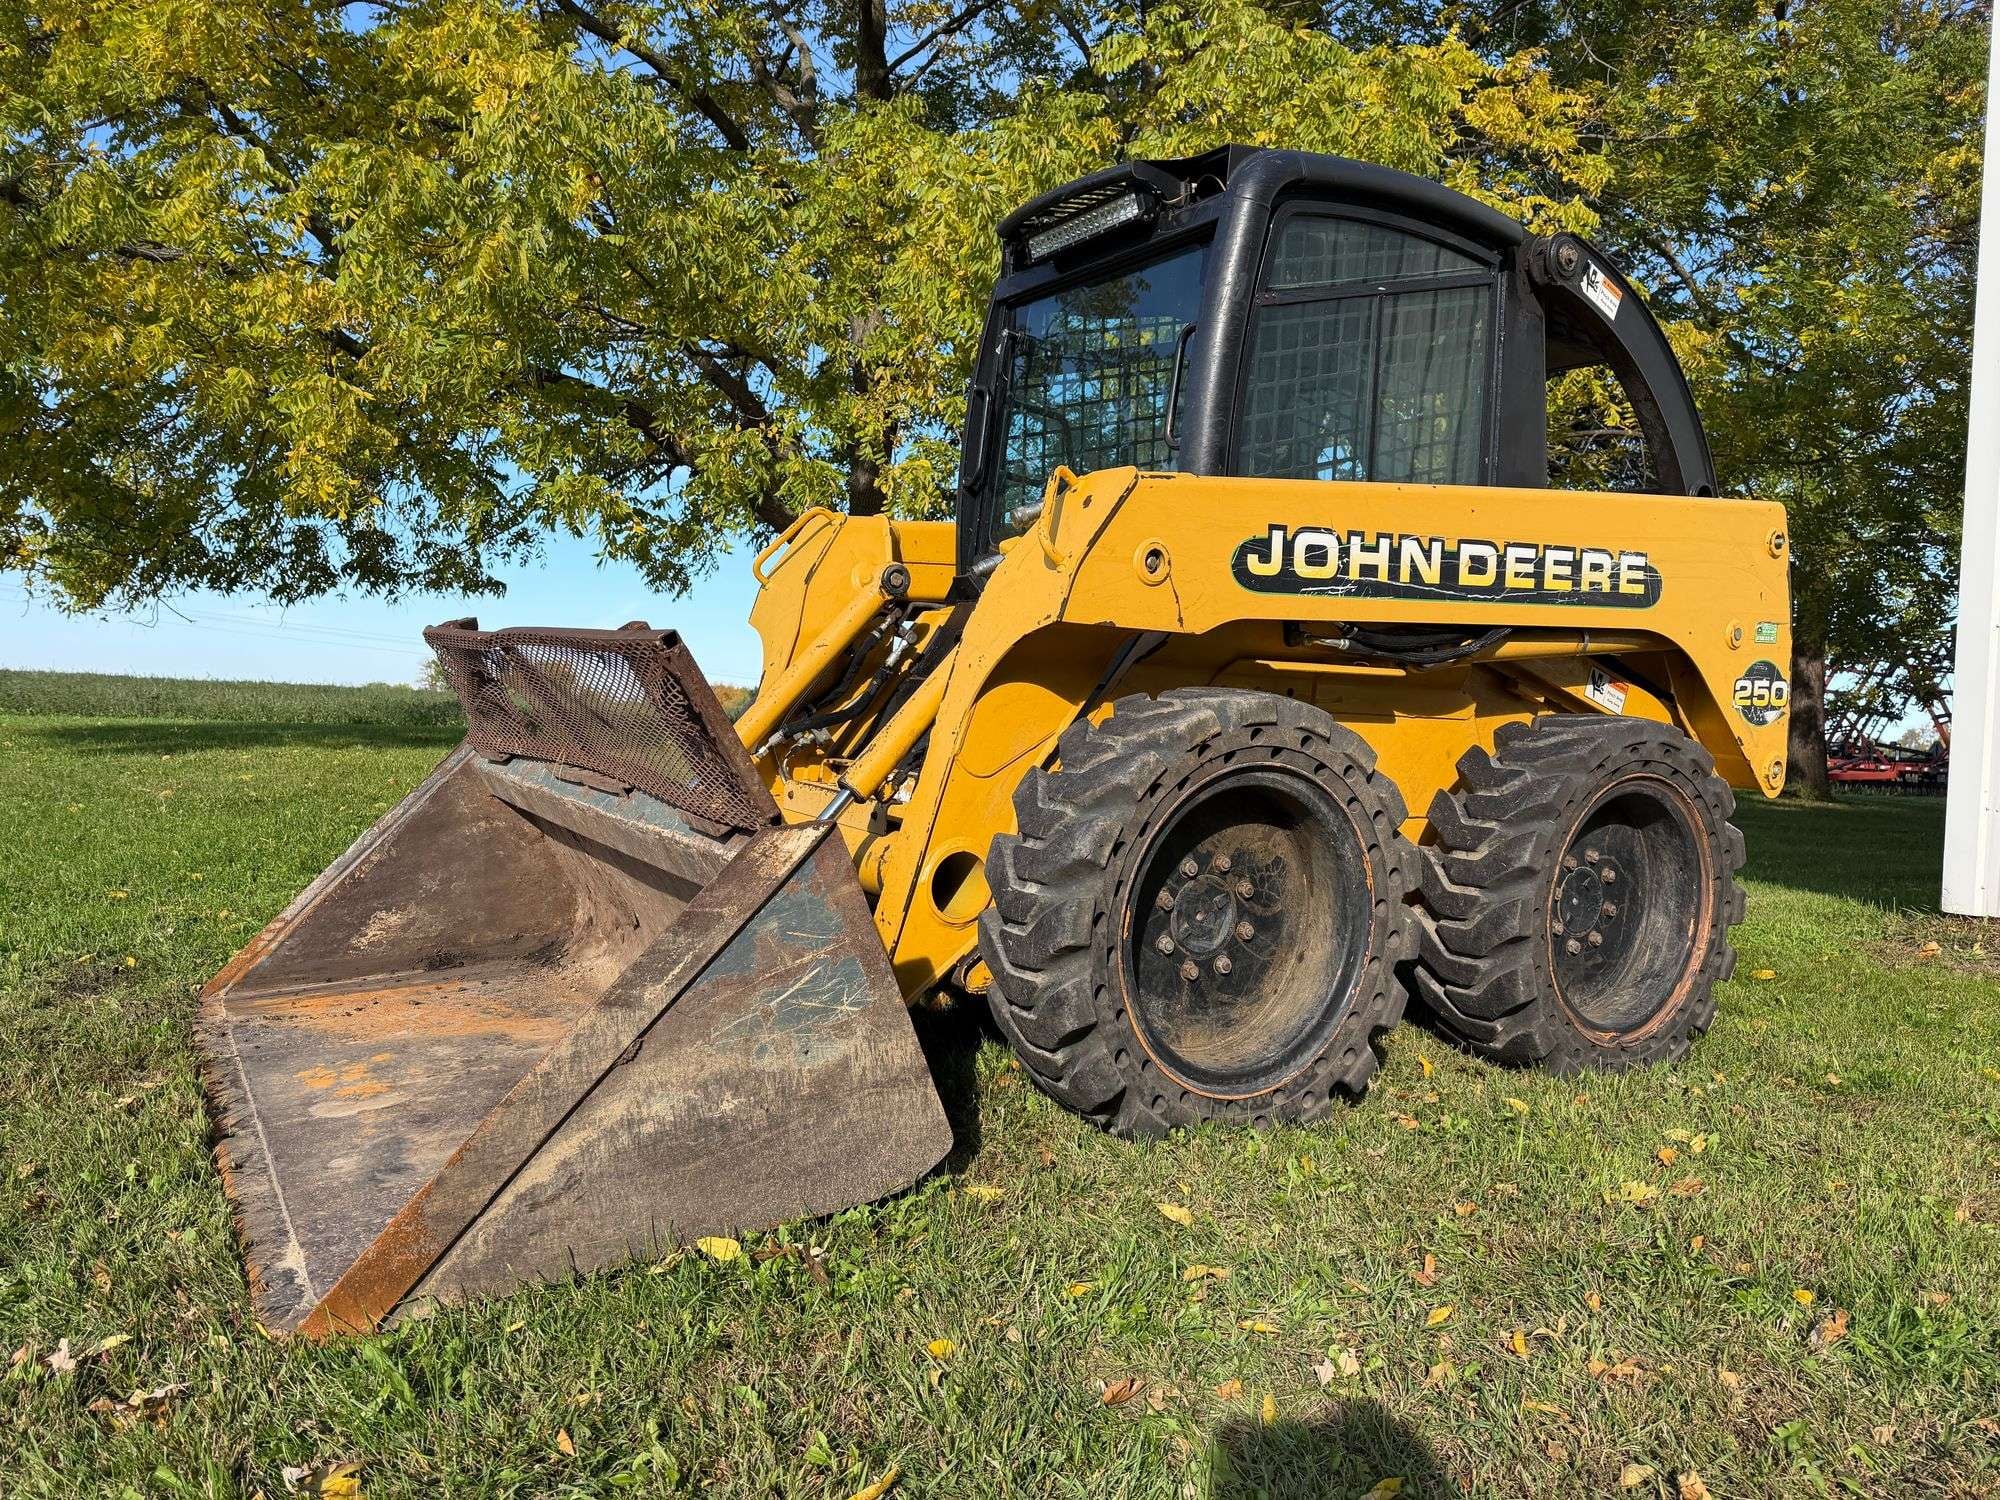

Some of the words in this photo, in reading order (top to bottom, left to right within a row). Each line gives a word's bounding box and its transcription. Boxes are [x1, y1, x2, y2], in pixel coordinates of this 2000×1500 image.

[1247, 529, 1441, 584] JOHN
[1459, 543, 1647, 594] DEERE
[1734, 679, 1788, 707] 250
